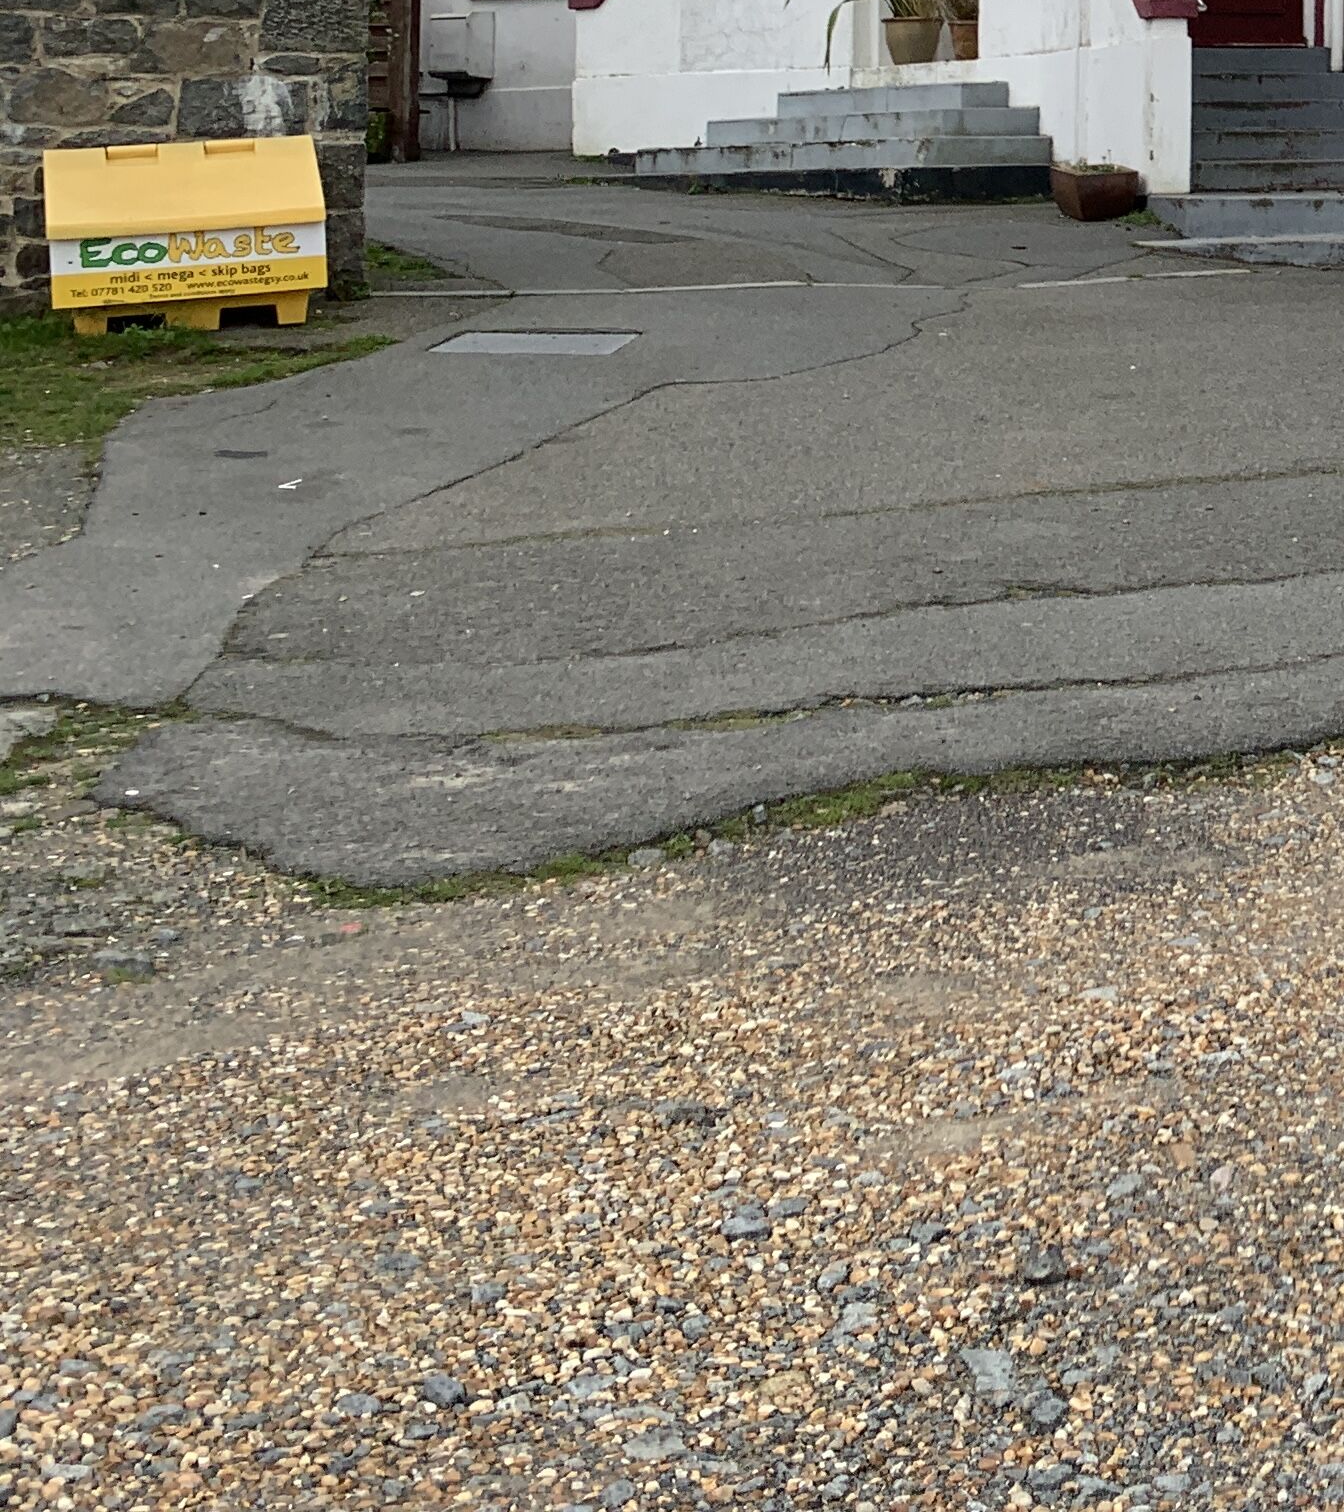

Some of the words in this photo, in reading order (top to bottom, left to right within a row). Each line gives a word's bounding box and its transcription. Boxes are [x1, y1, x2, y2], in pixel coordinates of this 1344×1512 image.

[79, 226, 301, 269] EcoWaste
[110, 271, 141, 284] midi
[157, 271, 195, 282] mega
[211, 266, 238, 278] skip
[241, 263, 271, 276] bags
[91, 286, 125, 297] 07781
